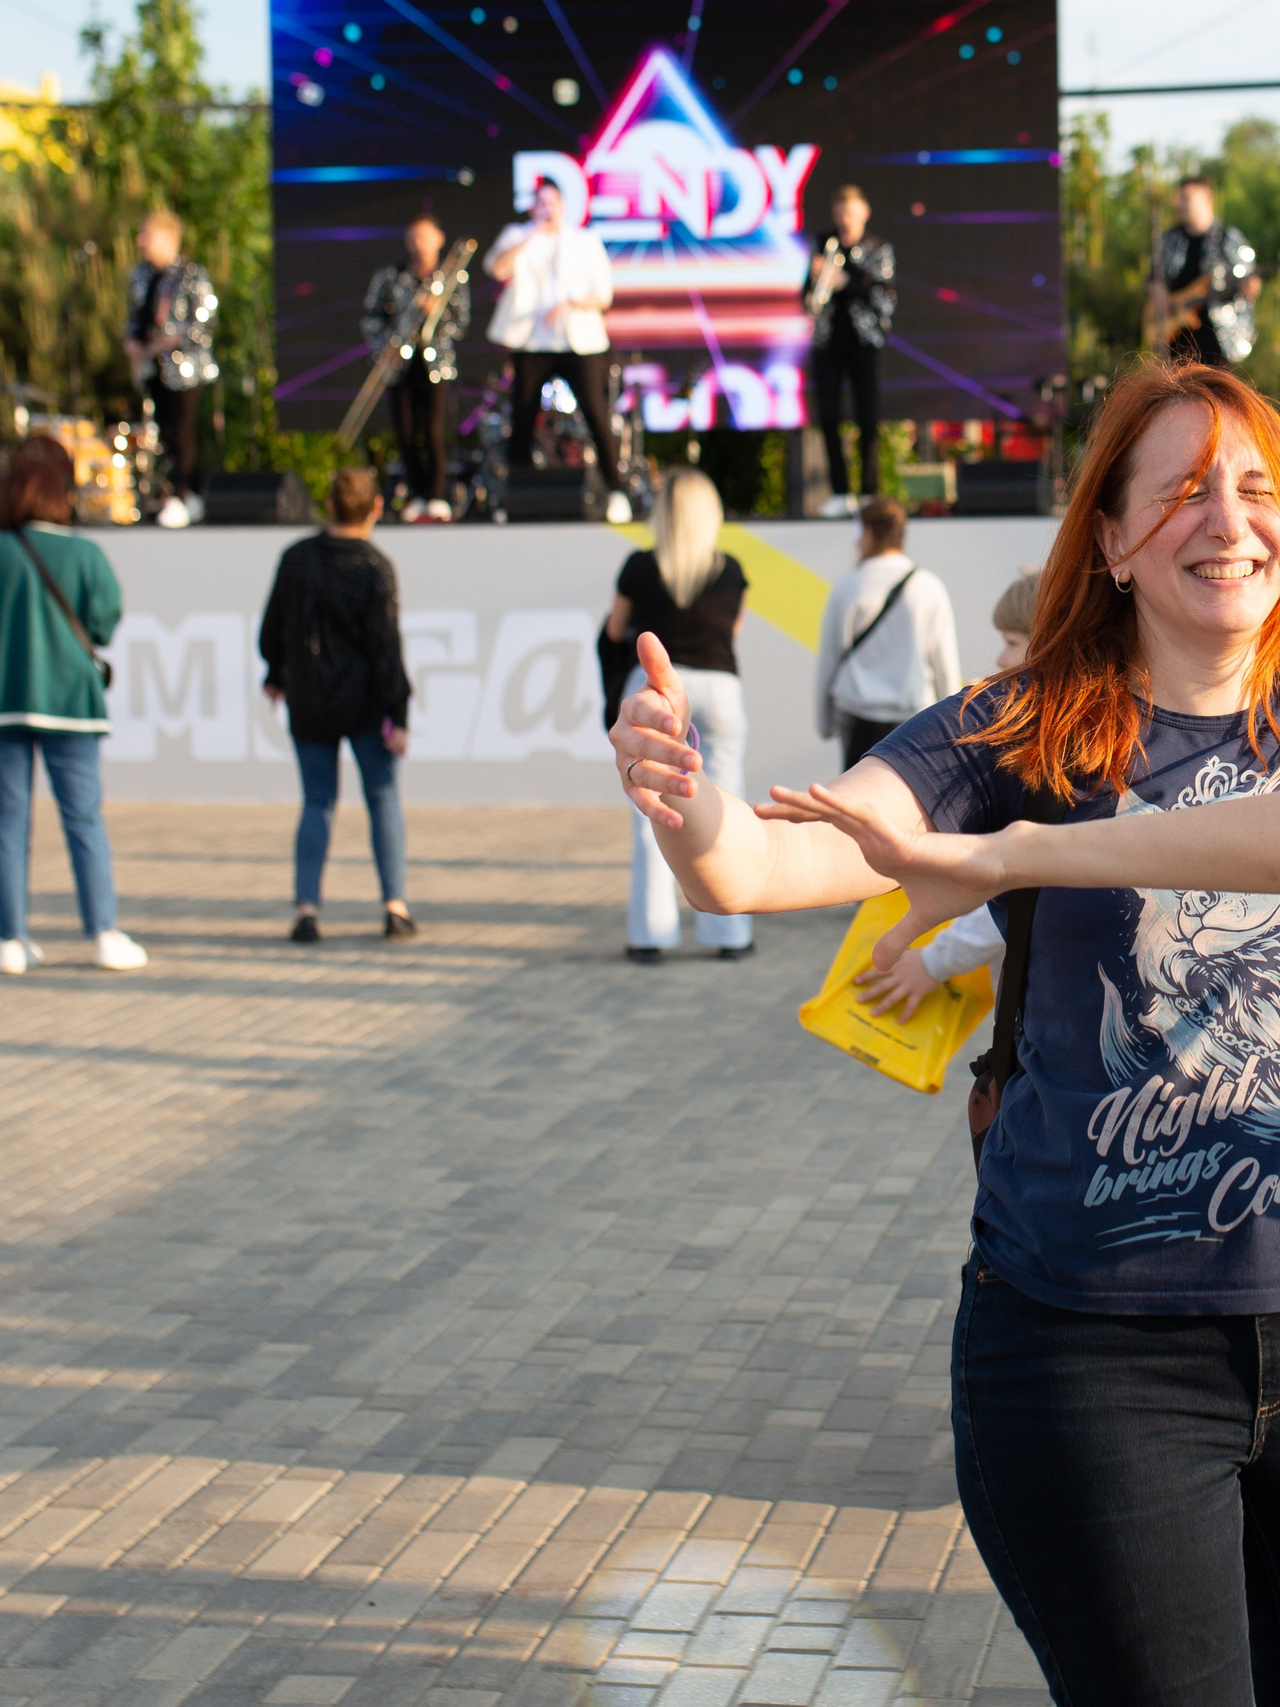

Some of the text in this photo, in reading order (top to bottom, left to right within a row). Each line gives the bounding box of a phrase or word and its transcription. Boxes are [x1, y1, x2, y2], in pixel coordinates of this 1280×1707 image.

[512, 143, 822, 242] DENDY
[1087, 1053, 1262, 1165] Night
[1083, 1141, 1233, 1208] brings
